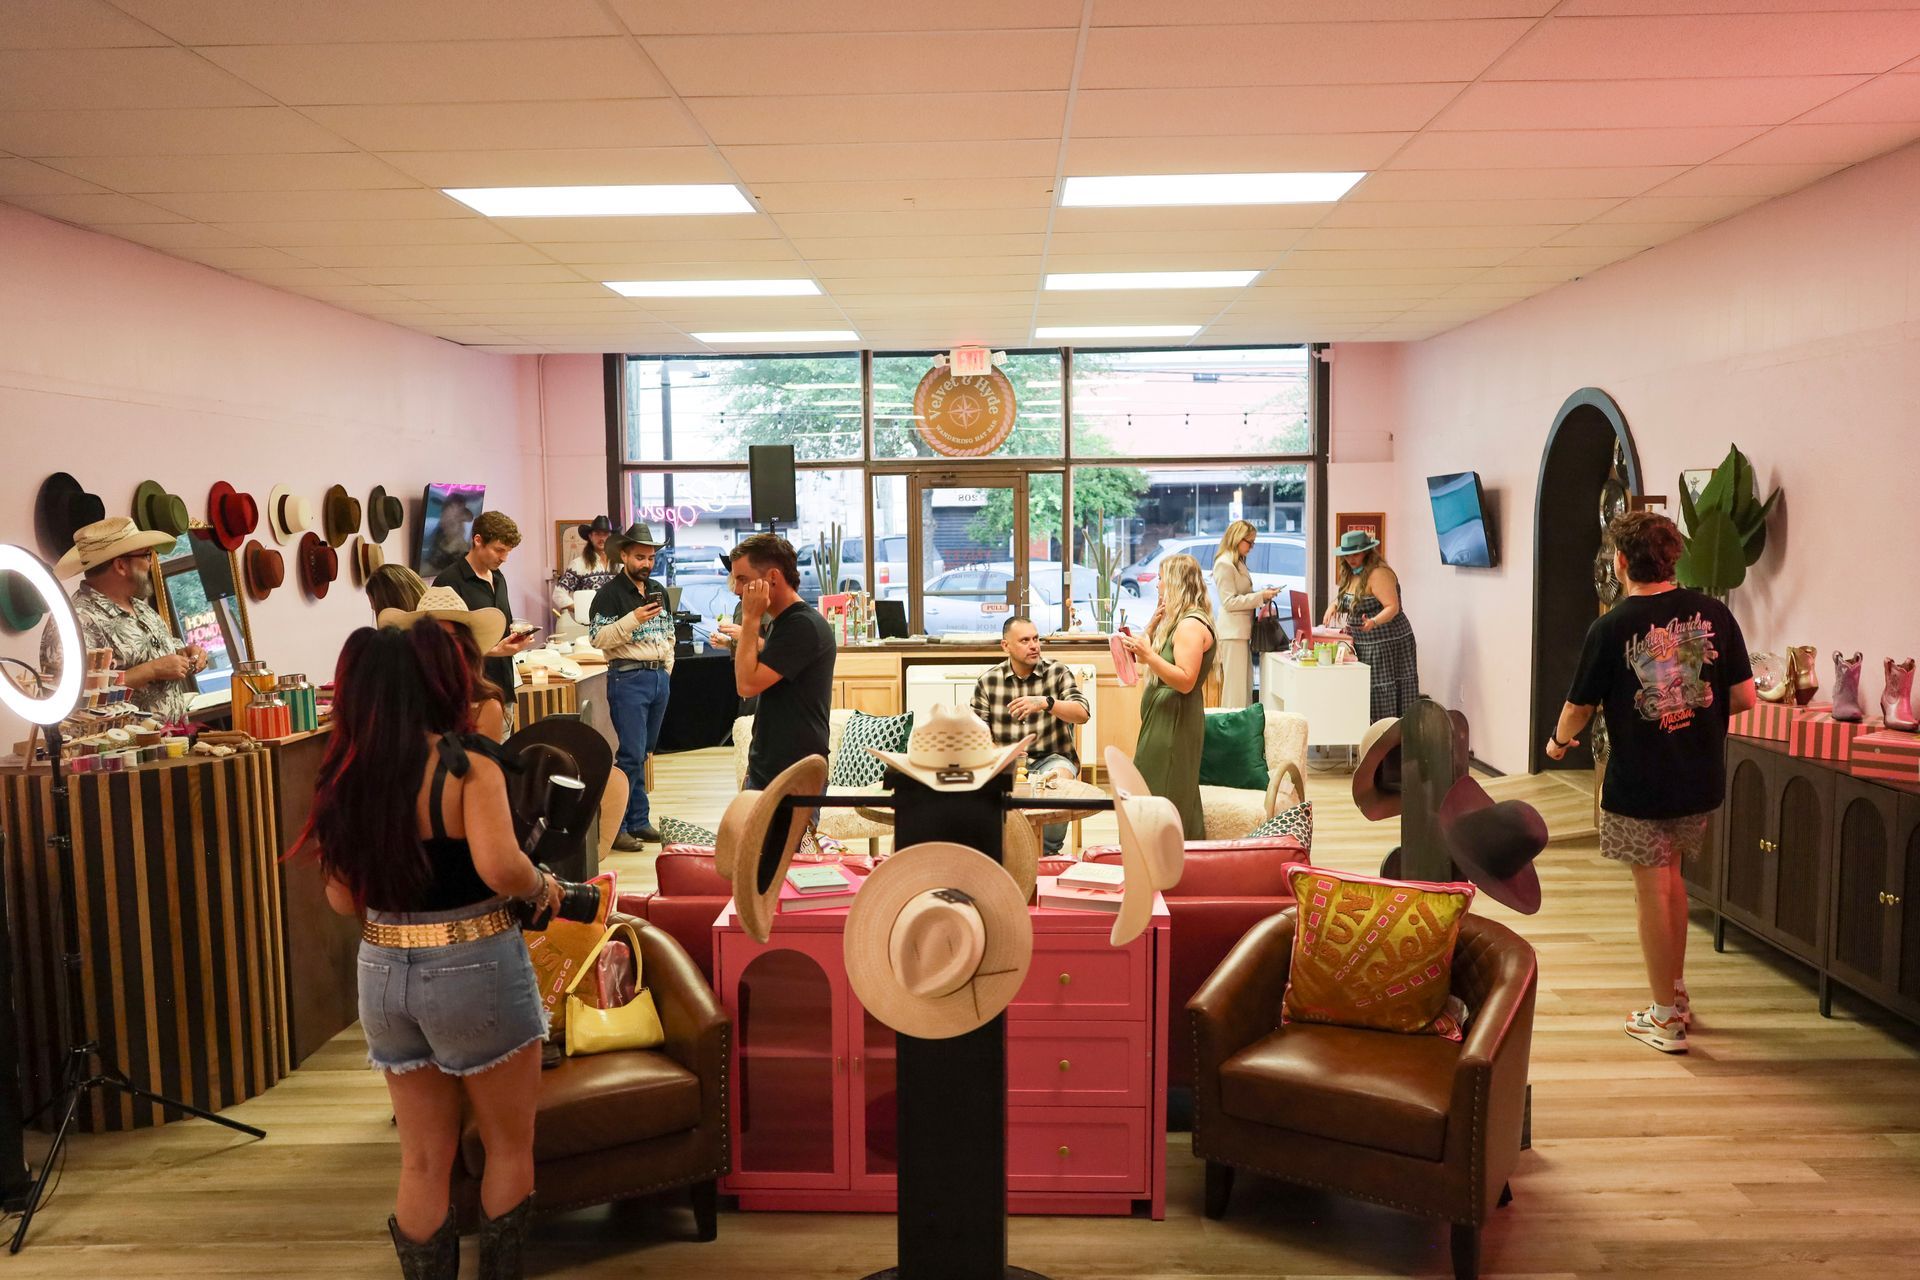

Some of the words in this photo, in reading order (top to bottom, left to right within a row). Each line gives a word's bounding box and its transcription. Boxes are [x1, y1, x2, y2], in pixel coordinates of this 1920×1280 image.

[928, 375, 960, 420] Velvet
[974, 376, 1001, 415] Hyde
[1625, 623, 1666, 669] Harley
[1665, 611, 1713, 641] Davidson
